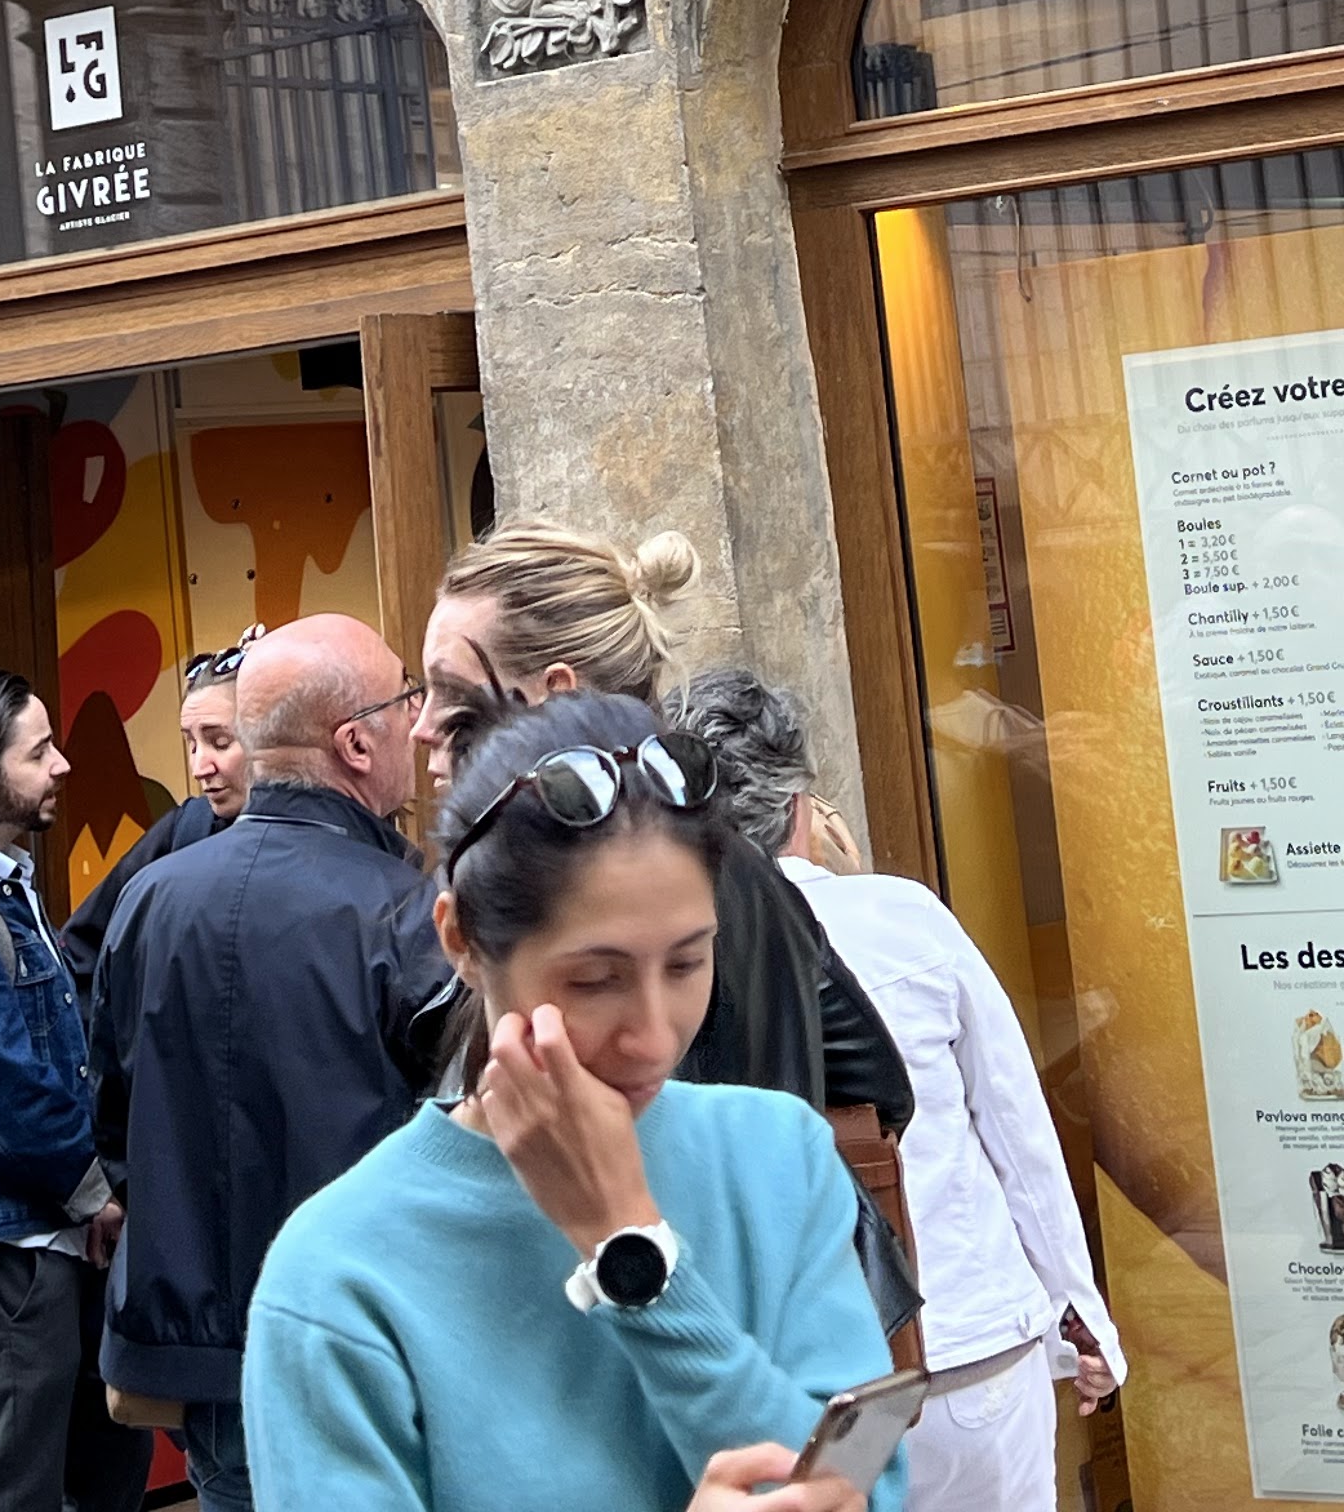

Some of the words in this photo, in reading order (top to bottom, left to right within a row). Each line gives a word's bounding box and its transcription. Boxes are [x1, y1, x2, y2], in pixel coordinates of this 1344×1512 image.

[35, 159, 56, 178] LA
[63, 142, 146, 173] FABRIQUE
[36, 164, 151, 216] GIVRÉE
[59, 217, 93, 231] ARTISTE
[95, 211, 130, 225] GLACIER
[1184, 383, 1266, 413] Créez
[1170, 468, 1218, 484] Cornet
[1220, 469, 1238, 479] ou
[1241, 463, 1266, 480] pot
[1176, 517, 1222, 533] Boules
[1178, 538, 1184, 550] 1
[1179, 552, 1188, 565] 2
[1182, 568, 1190, 580] 3
[1183, 581, 1220, 595] Boule
[1222, 581, 1248, 594] sup.
[1187, 608, 1249, 626] Chantilly
[1192, 653, 1234, 668] Sauce
[1197, 694, 1284, 712] Croustillants
[1207, 779, 1246, 793] Fruits
[1285, 841, 1341, 856] Assiette
[1240, 943, 1289, 970] Les
[1255, 1108, 1307, 1123] Pavlova
[1301, 1423, 1333, 1437] Folie
